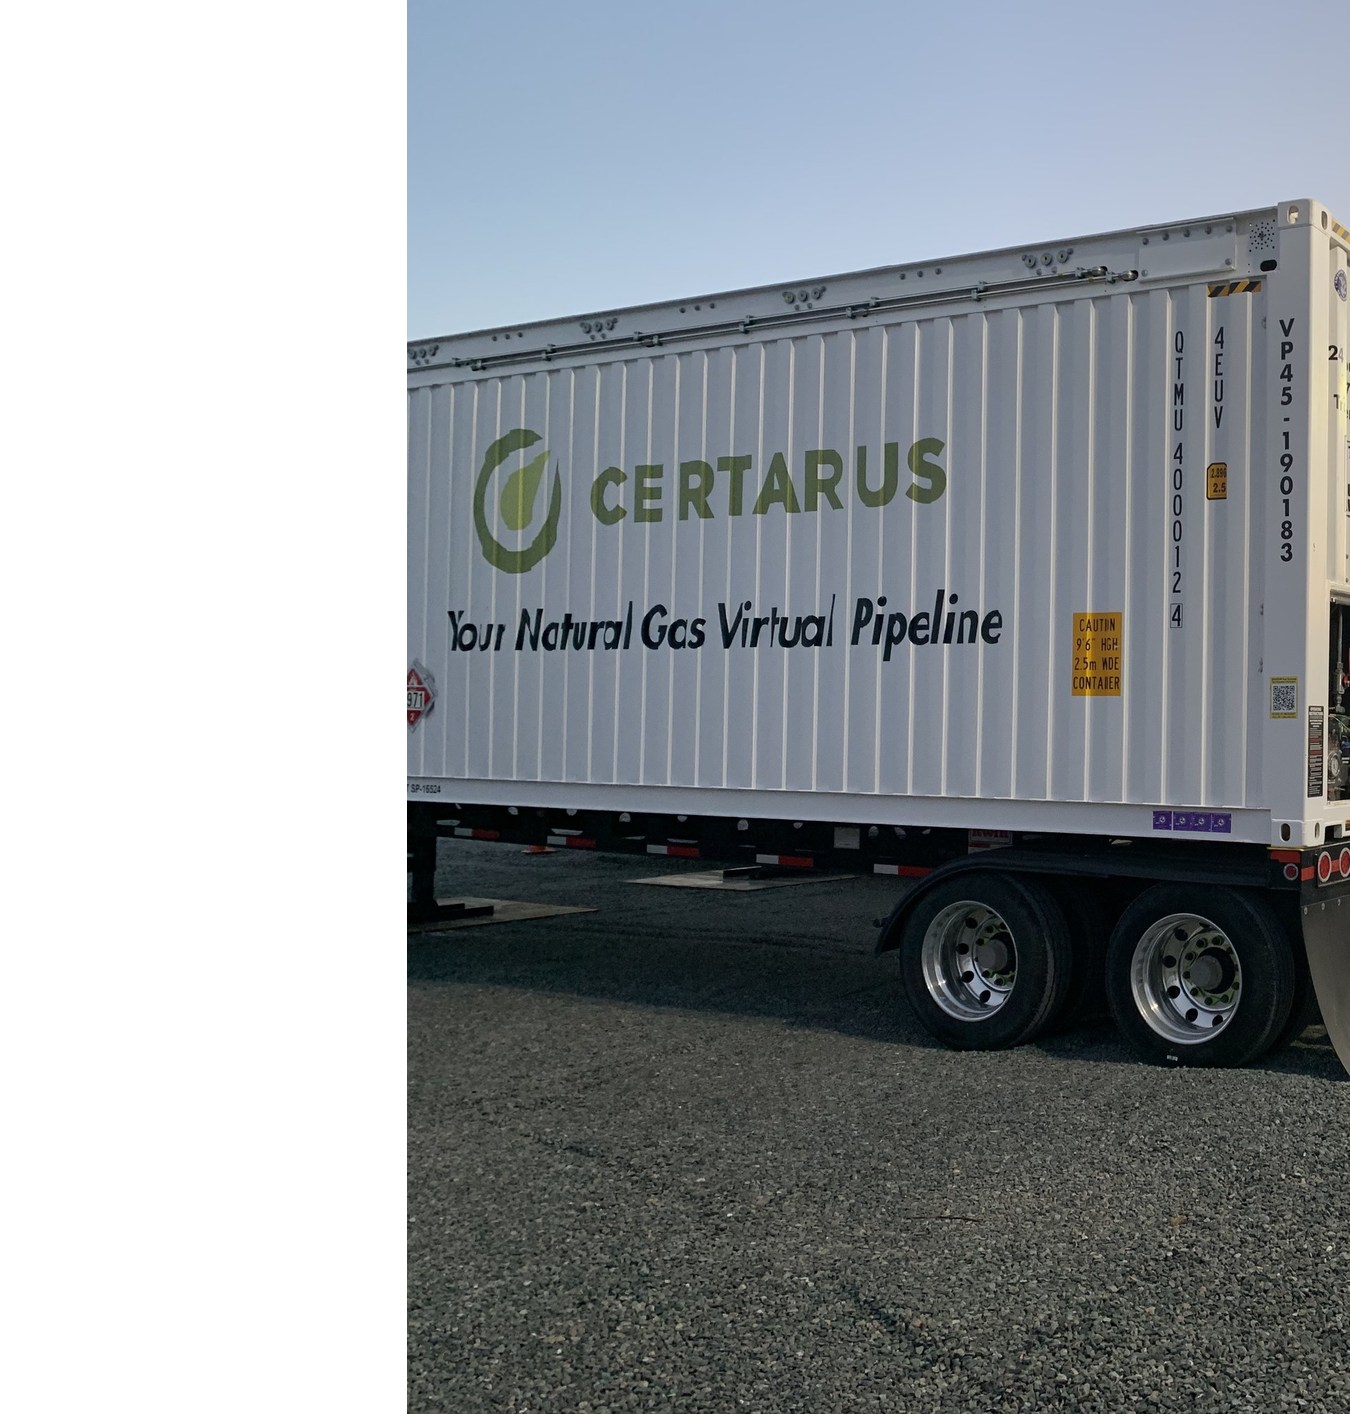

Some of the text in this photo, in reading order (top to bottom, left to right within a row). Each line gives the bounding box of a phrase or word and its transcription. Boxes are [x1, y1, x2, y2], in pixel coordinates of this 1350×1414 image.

[1173, 331, 1184, 431] QTMU
[1214, 326, 1225, 429] 4EUV
[590, 437, 947, 526] CERTARUS
[1279, 318, 1295, 562] VP45-190183
[1172, 442, 1183, 594] 400012
[1212, 482, 1227, 494] 2.5
[447, 589, 1003, 662] Your Natural Gas Virtual Pipeline
[1074, 657, 1097, 671] 2.5m
